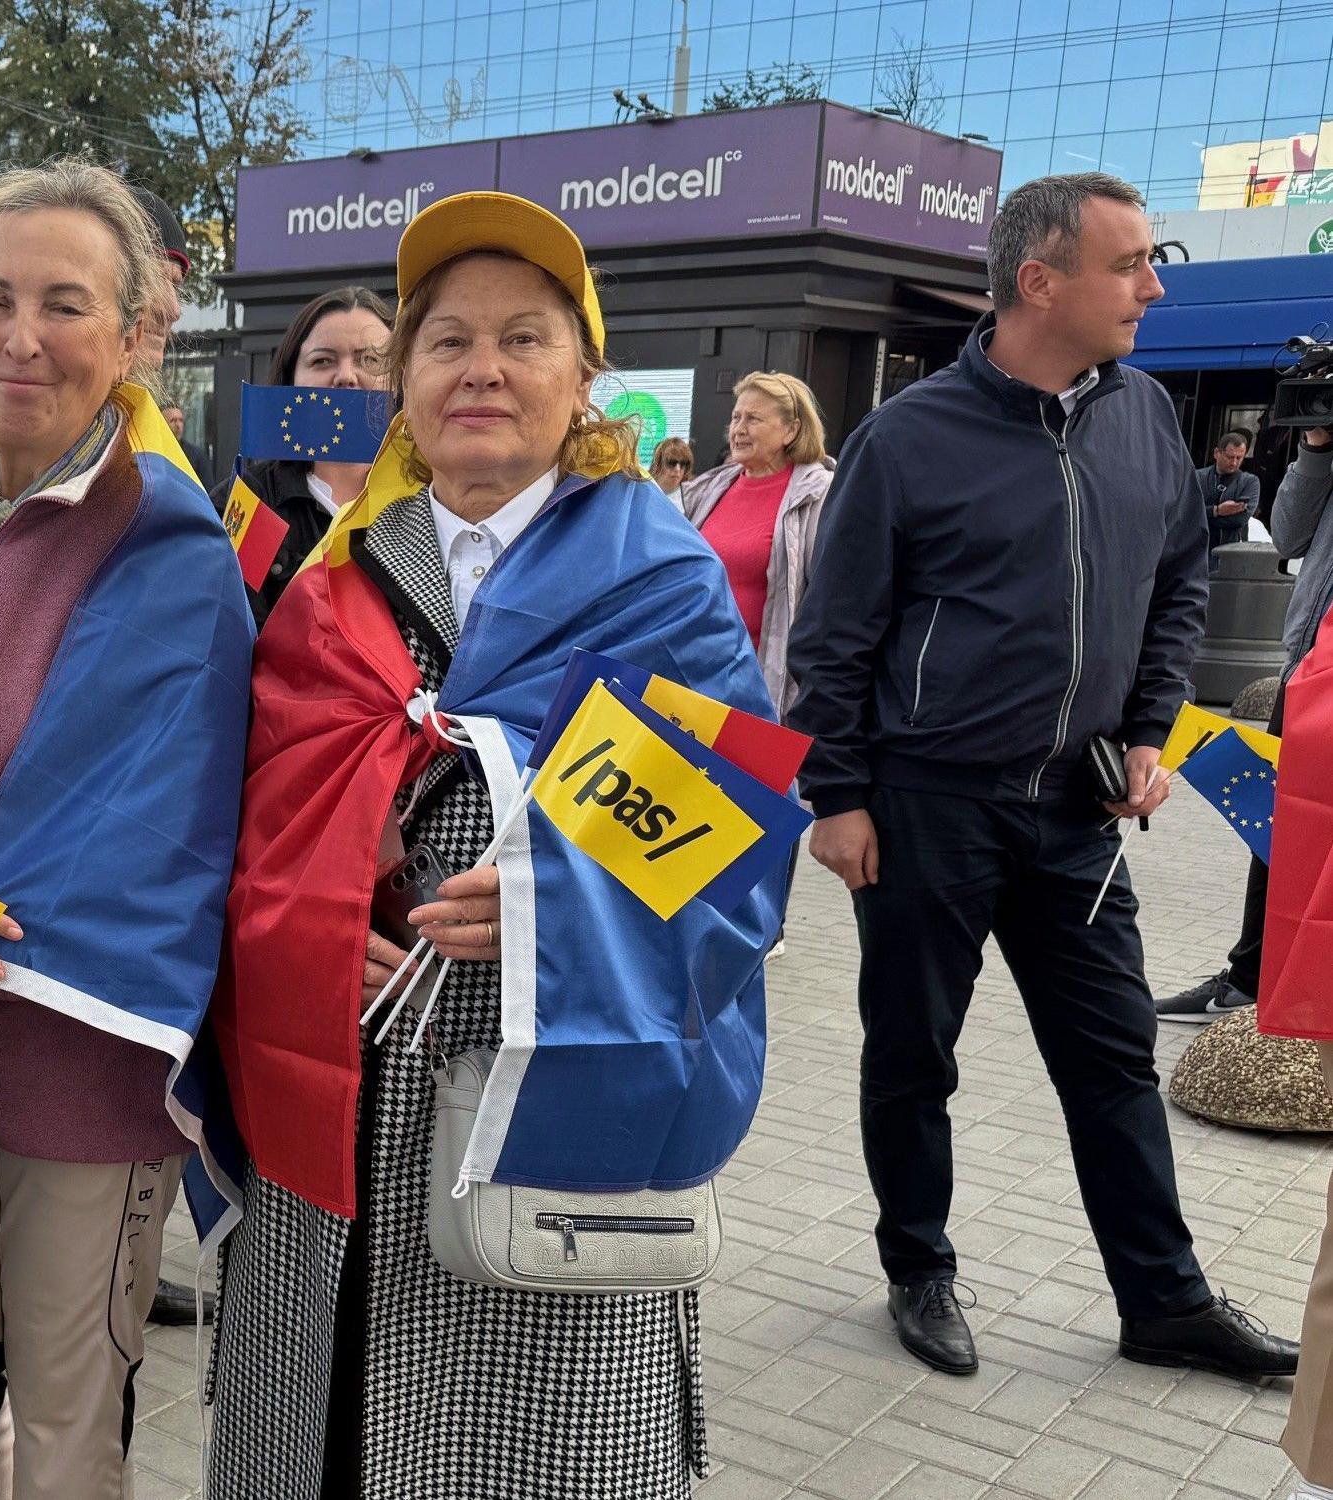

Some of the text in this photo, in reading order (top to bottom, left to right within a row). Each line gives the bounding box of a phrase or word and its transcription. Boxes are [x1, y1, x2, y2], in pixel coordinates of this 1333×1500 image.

[560, 157, 723, 211] moldcell
[825, 156, 905, 206] moldcell
[919, 179, 986, 225] moldcell
[287, 187, 419, 236] moldcell
